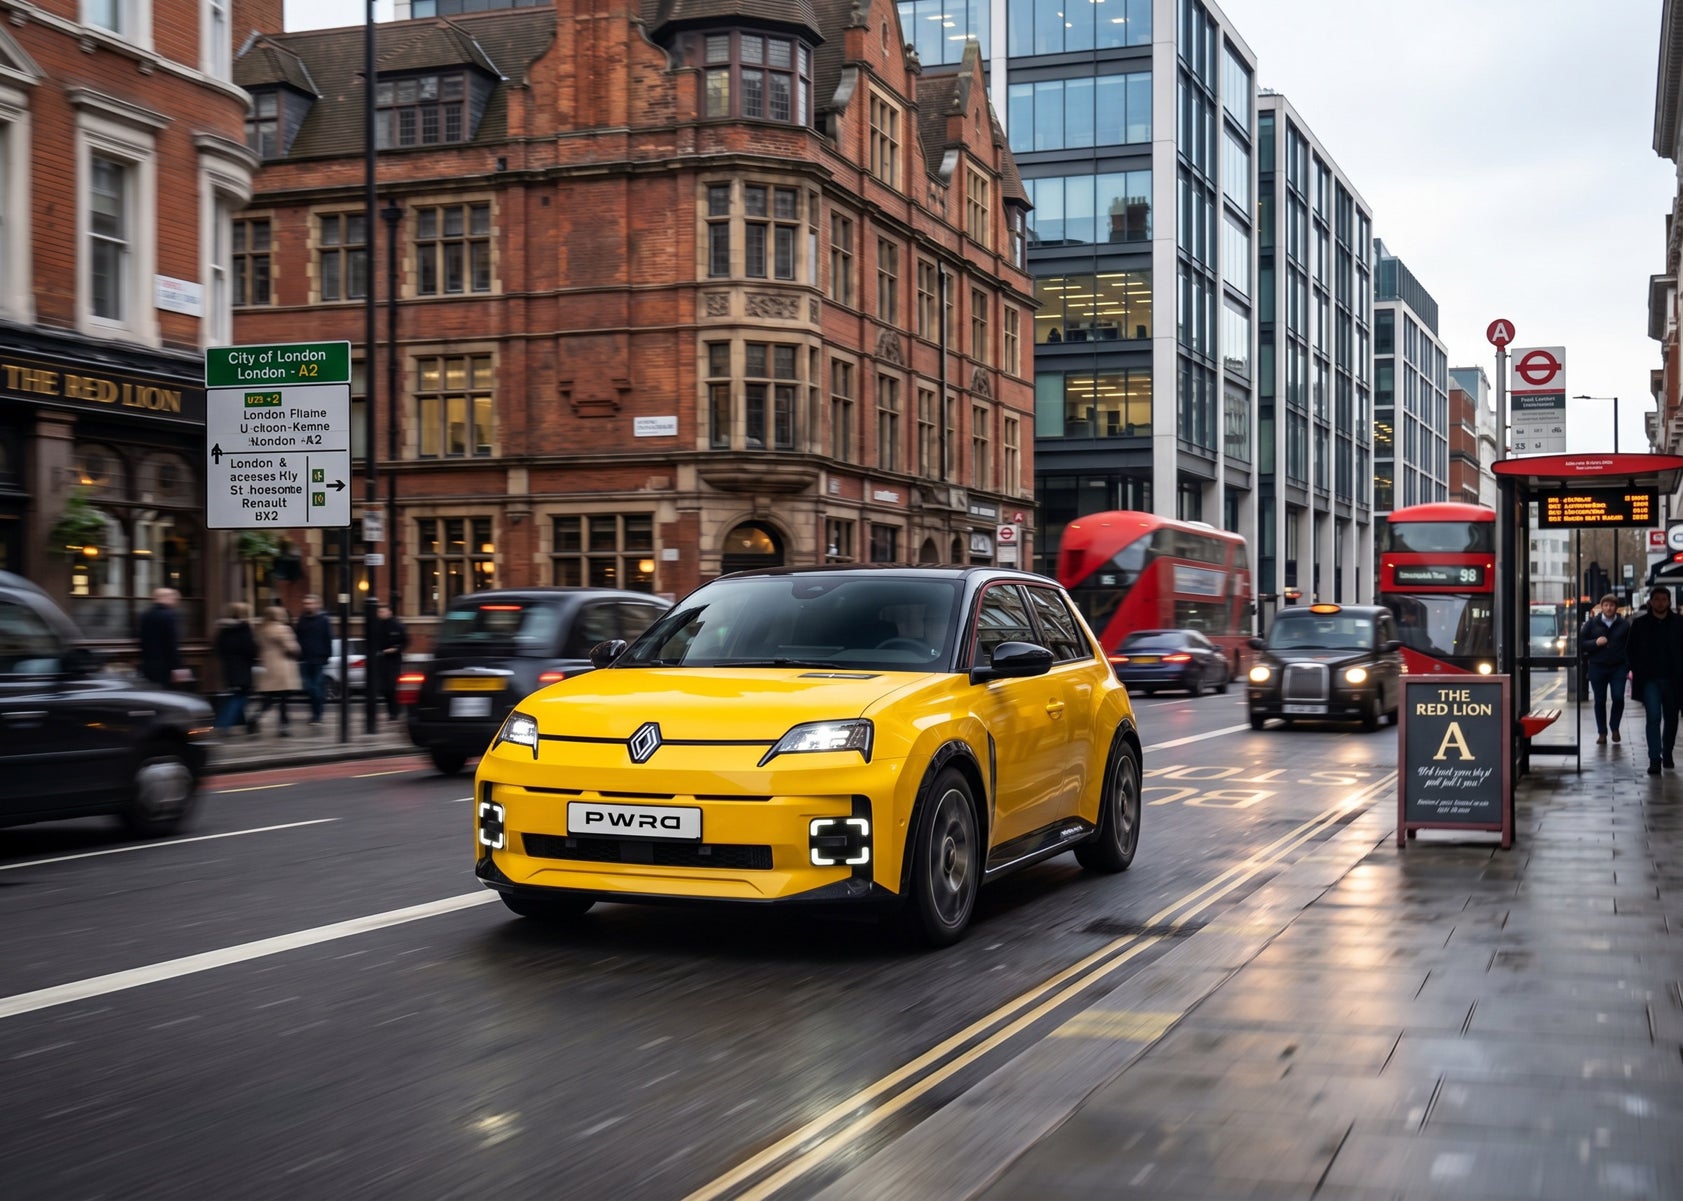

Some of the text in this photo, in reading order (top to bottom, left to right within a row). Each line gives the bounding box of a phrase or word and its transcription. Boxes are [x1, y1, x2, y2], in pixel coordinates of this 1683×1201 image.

[1491, 322, 1510, 341] A
[228, 349, 326, 366] City of London
[238, 367, 286, 380] London
[298, 364, 318, 377] A2
[2, 364, 182, 413] THE RED LION
[243, 410, 286, 420] London
[230, 457, 288, 469] London &
[230, 473, 276, 482] aceeses
[230, 485, 244, 496] St
[242, 498, 288, 509] Renault
[1460, 568, 1477, 582] 98
[1438, 689, 1471, 702] THE
[1416, 703, 1492, 716] RED LION
[1432, 721, 1476, 761] A
[1141, 786, 1278, 809] BU
